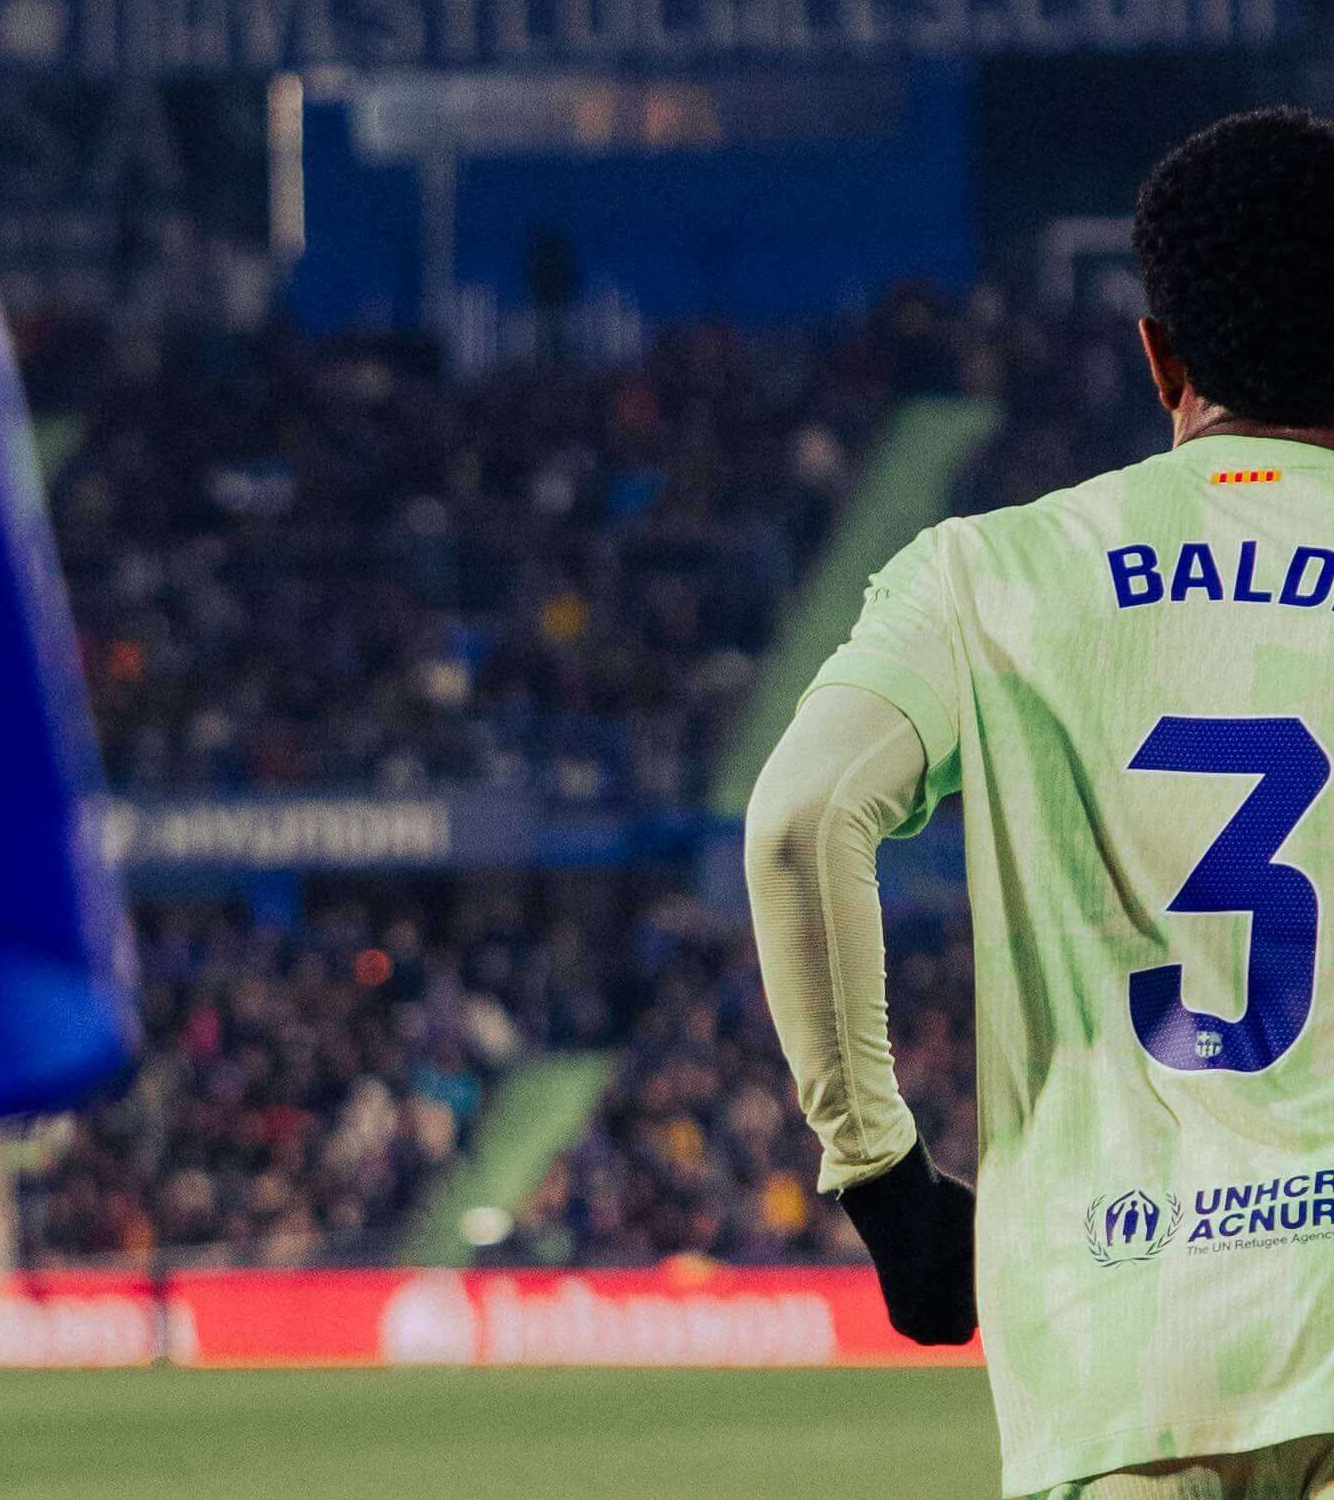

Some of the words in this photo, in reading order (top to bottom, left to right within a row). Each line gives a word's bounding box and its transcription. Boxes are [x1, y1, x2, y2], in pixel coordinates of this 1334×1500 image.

[1127, 715, 1332, 1073] 3
[1186, 1245, 1210, 1256] The
[1212, 1241, 1231, 1252] UN
[1235, 1236, 1288, 1251] Refugee
